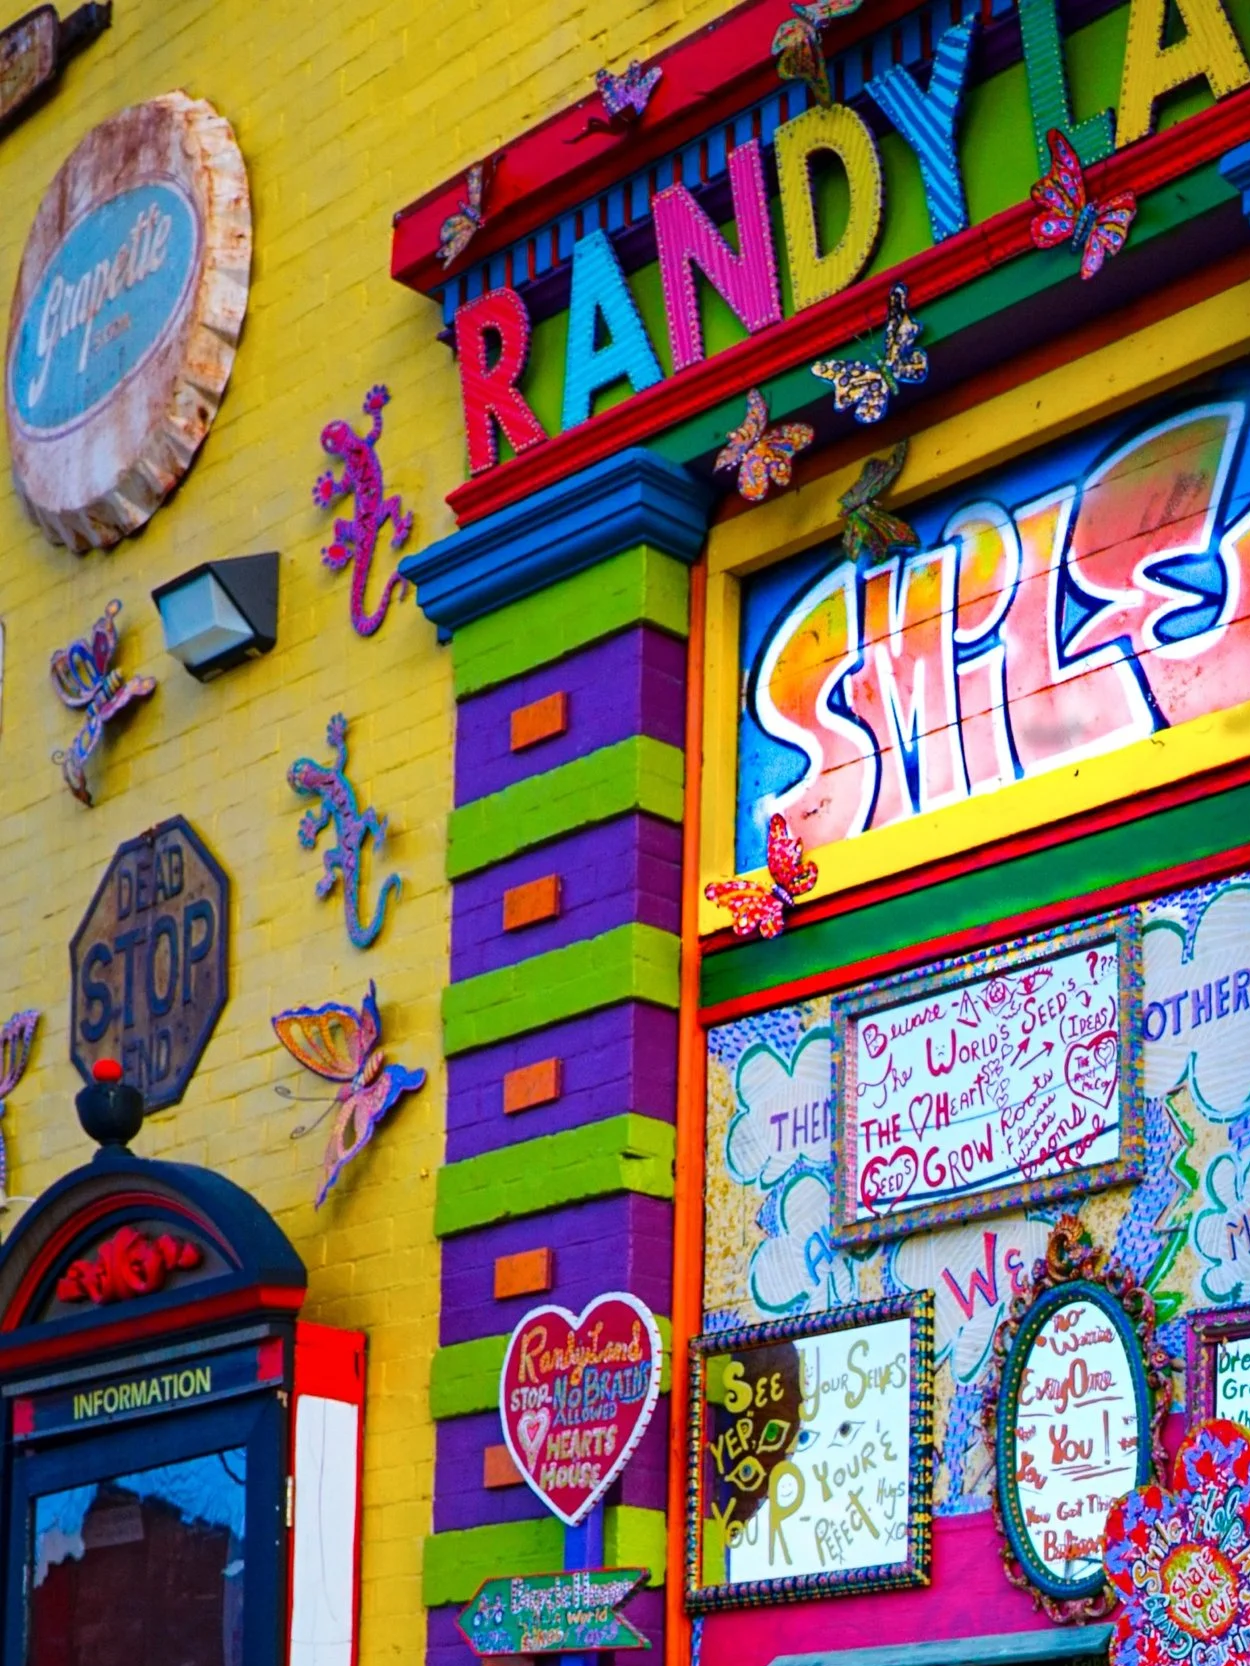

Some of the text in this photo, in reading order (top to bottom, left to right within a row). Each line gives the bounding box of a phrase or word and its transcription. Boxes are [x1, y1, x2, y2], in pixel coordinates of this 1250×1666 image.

[116, 844, 184, 921] DEAD
[80, 898, 216, 1043] STOP
[120, 1028, 171, 1084] END
[862, 1003, 948, 1059] Beware
[861, 1114, 902, 1153] THE
[923, 1123, 994, 1188] GROW
[942, 1230, 1025, 1320] WE
[73, 1366, 212, 1420] INFORMATION
[723, 1360, 785, 1413] SEE
[546, 1424, 618, 1461] HEARTS
